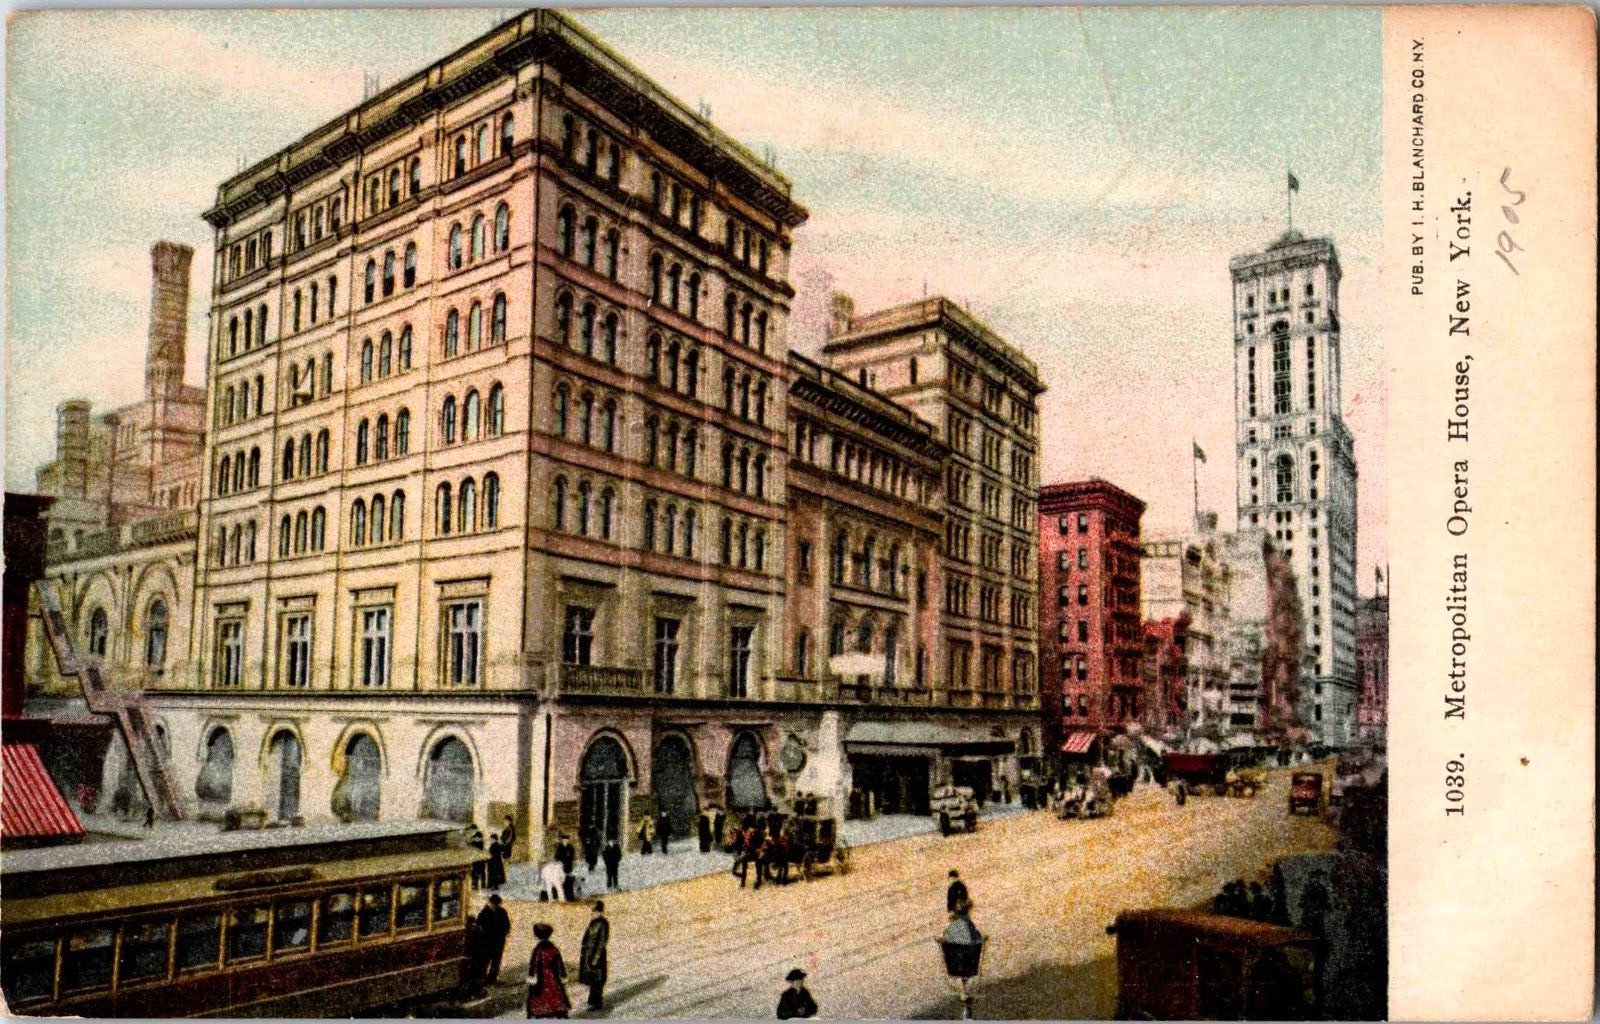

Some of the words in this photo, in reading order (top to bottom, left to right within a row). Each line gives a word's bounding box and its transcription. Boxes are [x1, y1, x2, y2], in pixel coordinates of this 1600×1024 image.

[1411, 65, 1425, 89] CO.
[1411, 93, 1424, 192] BLANCHARD
[1411, 233, 1424, 256] BY
[1449, 190, 1472, 262] York.
[1494, 166, 1526, 276] 1905
[1411, 260, 1424, 296] PUB.
[1449, 279, 1471, 337] New
[1447, 354, 1474, 442] House,
[1446, 459, 1473, 536] Opera
[1444, 553, 1472, 720] Metropolitan
[1445, 752, 1465, 817] 1039.
